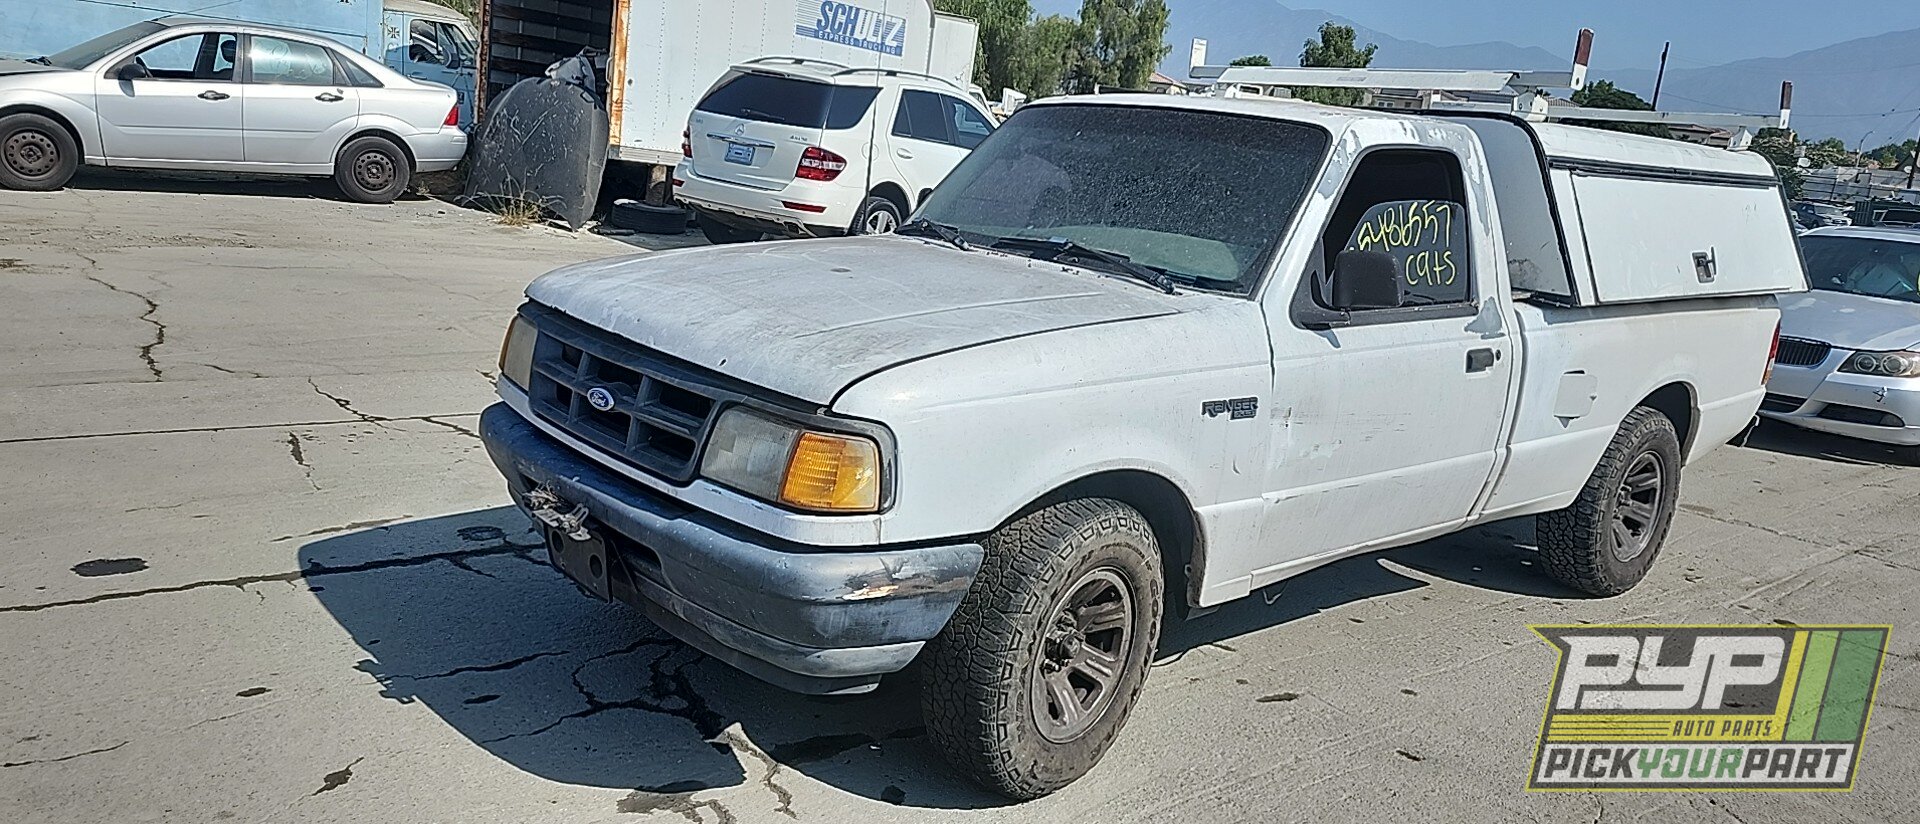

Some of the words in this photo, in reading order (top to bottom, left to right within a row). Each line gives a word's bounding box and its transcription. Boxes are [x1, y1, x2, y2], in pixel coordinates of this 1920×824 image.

[816, 1, 904, 47] SCHULTZ
[818, 31, 854, 46] EXPRESS
[1201, 397, 1259, 418] RANGER
